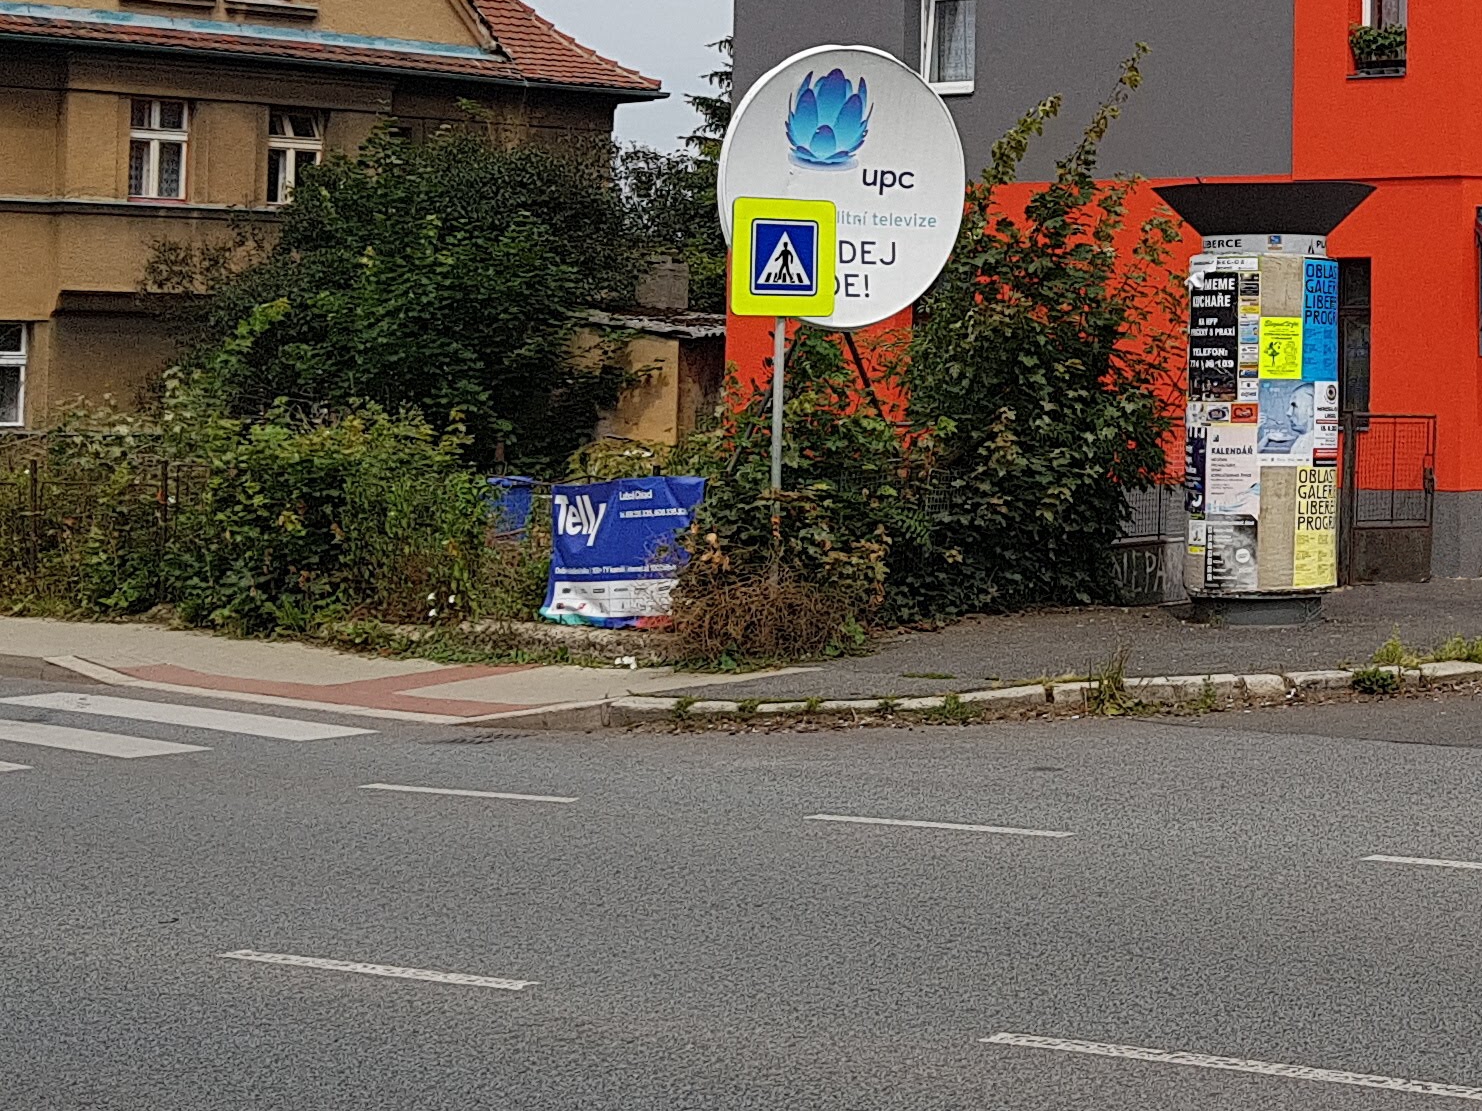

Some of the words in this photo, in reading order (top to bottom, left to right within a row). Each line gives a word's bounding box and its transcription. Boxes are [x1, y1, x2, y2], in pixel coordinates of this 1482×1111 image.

[862, 168, 915, 196] upc
[872, 212, 937, 228] televize
[838, 239, 896, 266] DEJ
[1211, 445, 1253, 455] KALENDÁŘ
[554, 494, 607, 547] Telly
